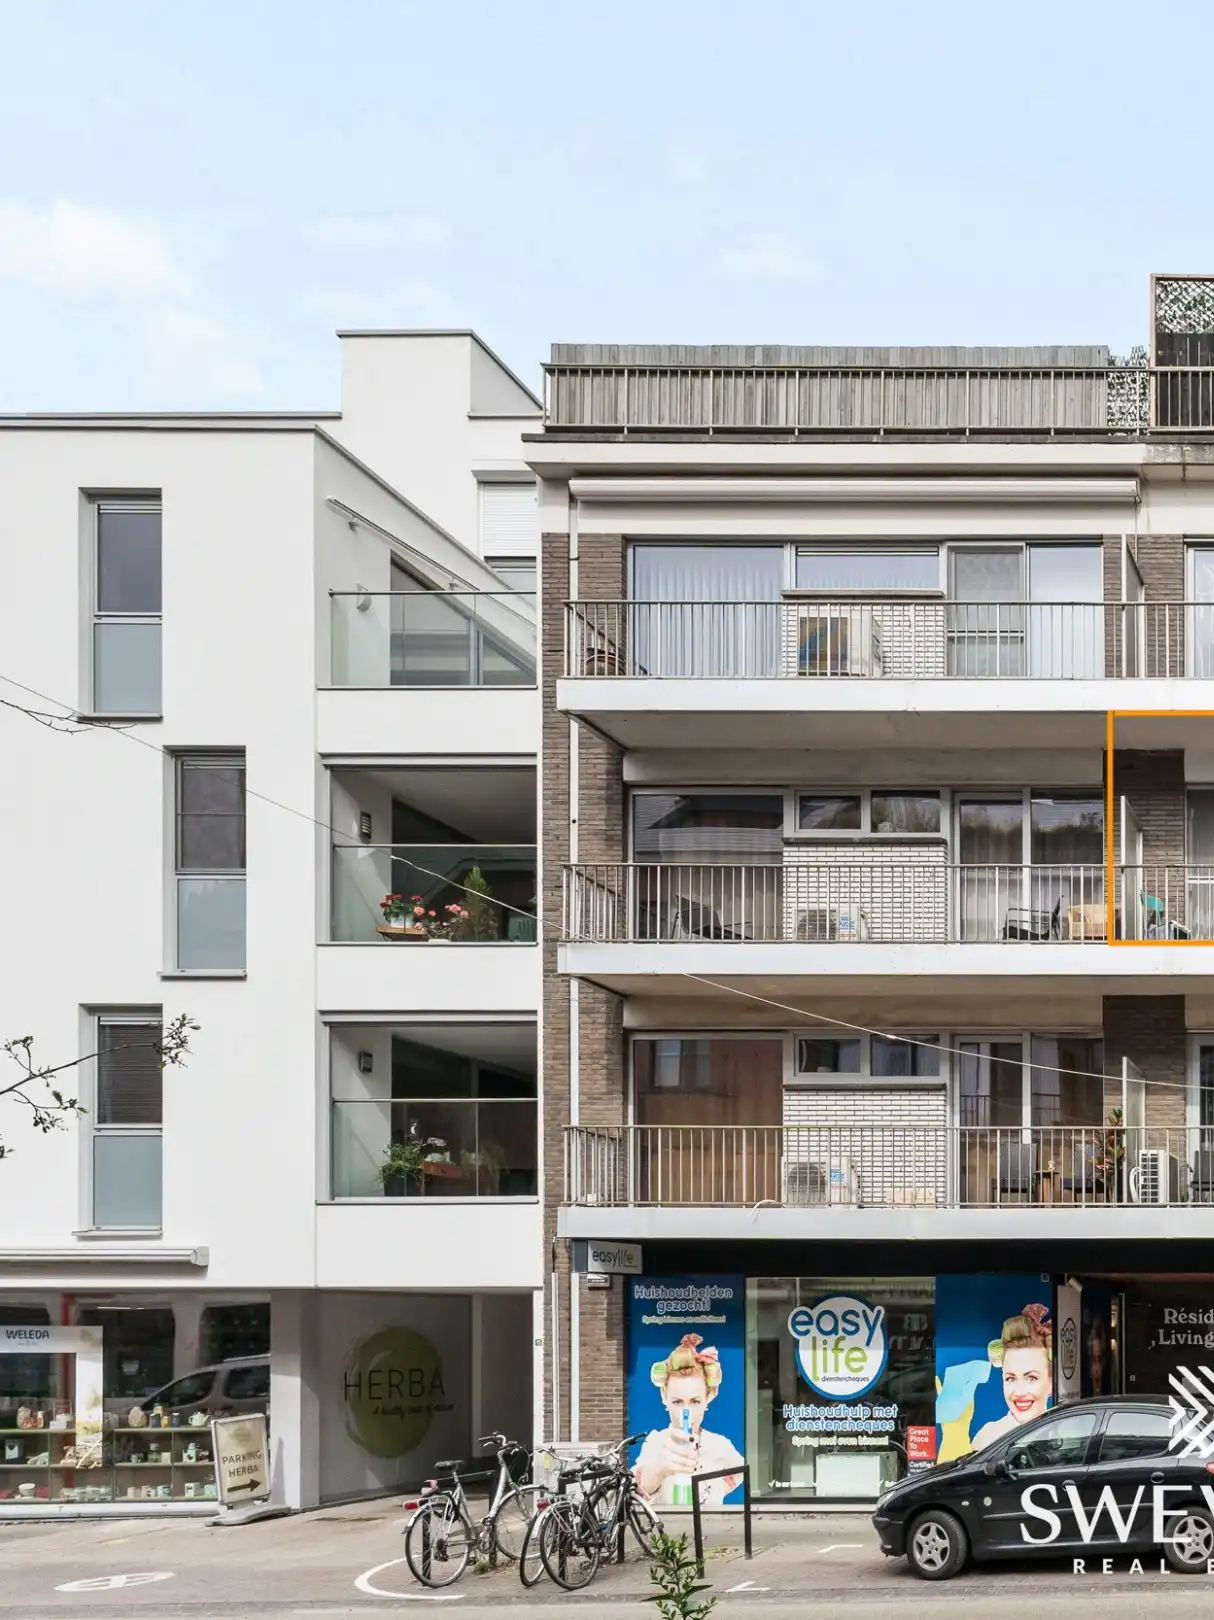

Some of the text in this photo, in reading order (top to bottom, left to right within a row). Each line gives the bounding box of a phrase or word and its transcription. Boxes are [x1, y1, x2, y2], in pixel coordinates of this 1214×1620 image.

[634, 1284, 734, 1299] Huishoudhelden
[656, 1298, 711, 1315] gezocht!
[5, 1329, 50, 1340] WELEDA
[789, 1309, 882, 1347] easy
[811, 1335, 868, 1381] life
[344, 1367, 446, 1402] HERBA
[821, 1375, 870, 1383] dienstencheques
[782, 1403, 899, 1420] Huishoudhulp met
[785, 1418, 895, 1434] dienstencheques
[909, 1427, 930, 1435] Great
[909, 1435, 929, 1443] Place
[909, 1442, 918, 1450] To
[221, 1450, 262, 1465] PARKING
[228, 1464, 261, 1478] HERBA
